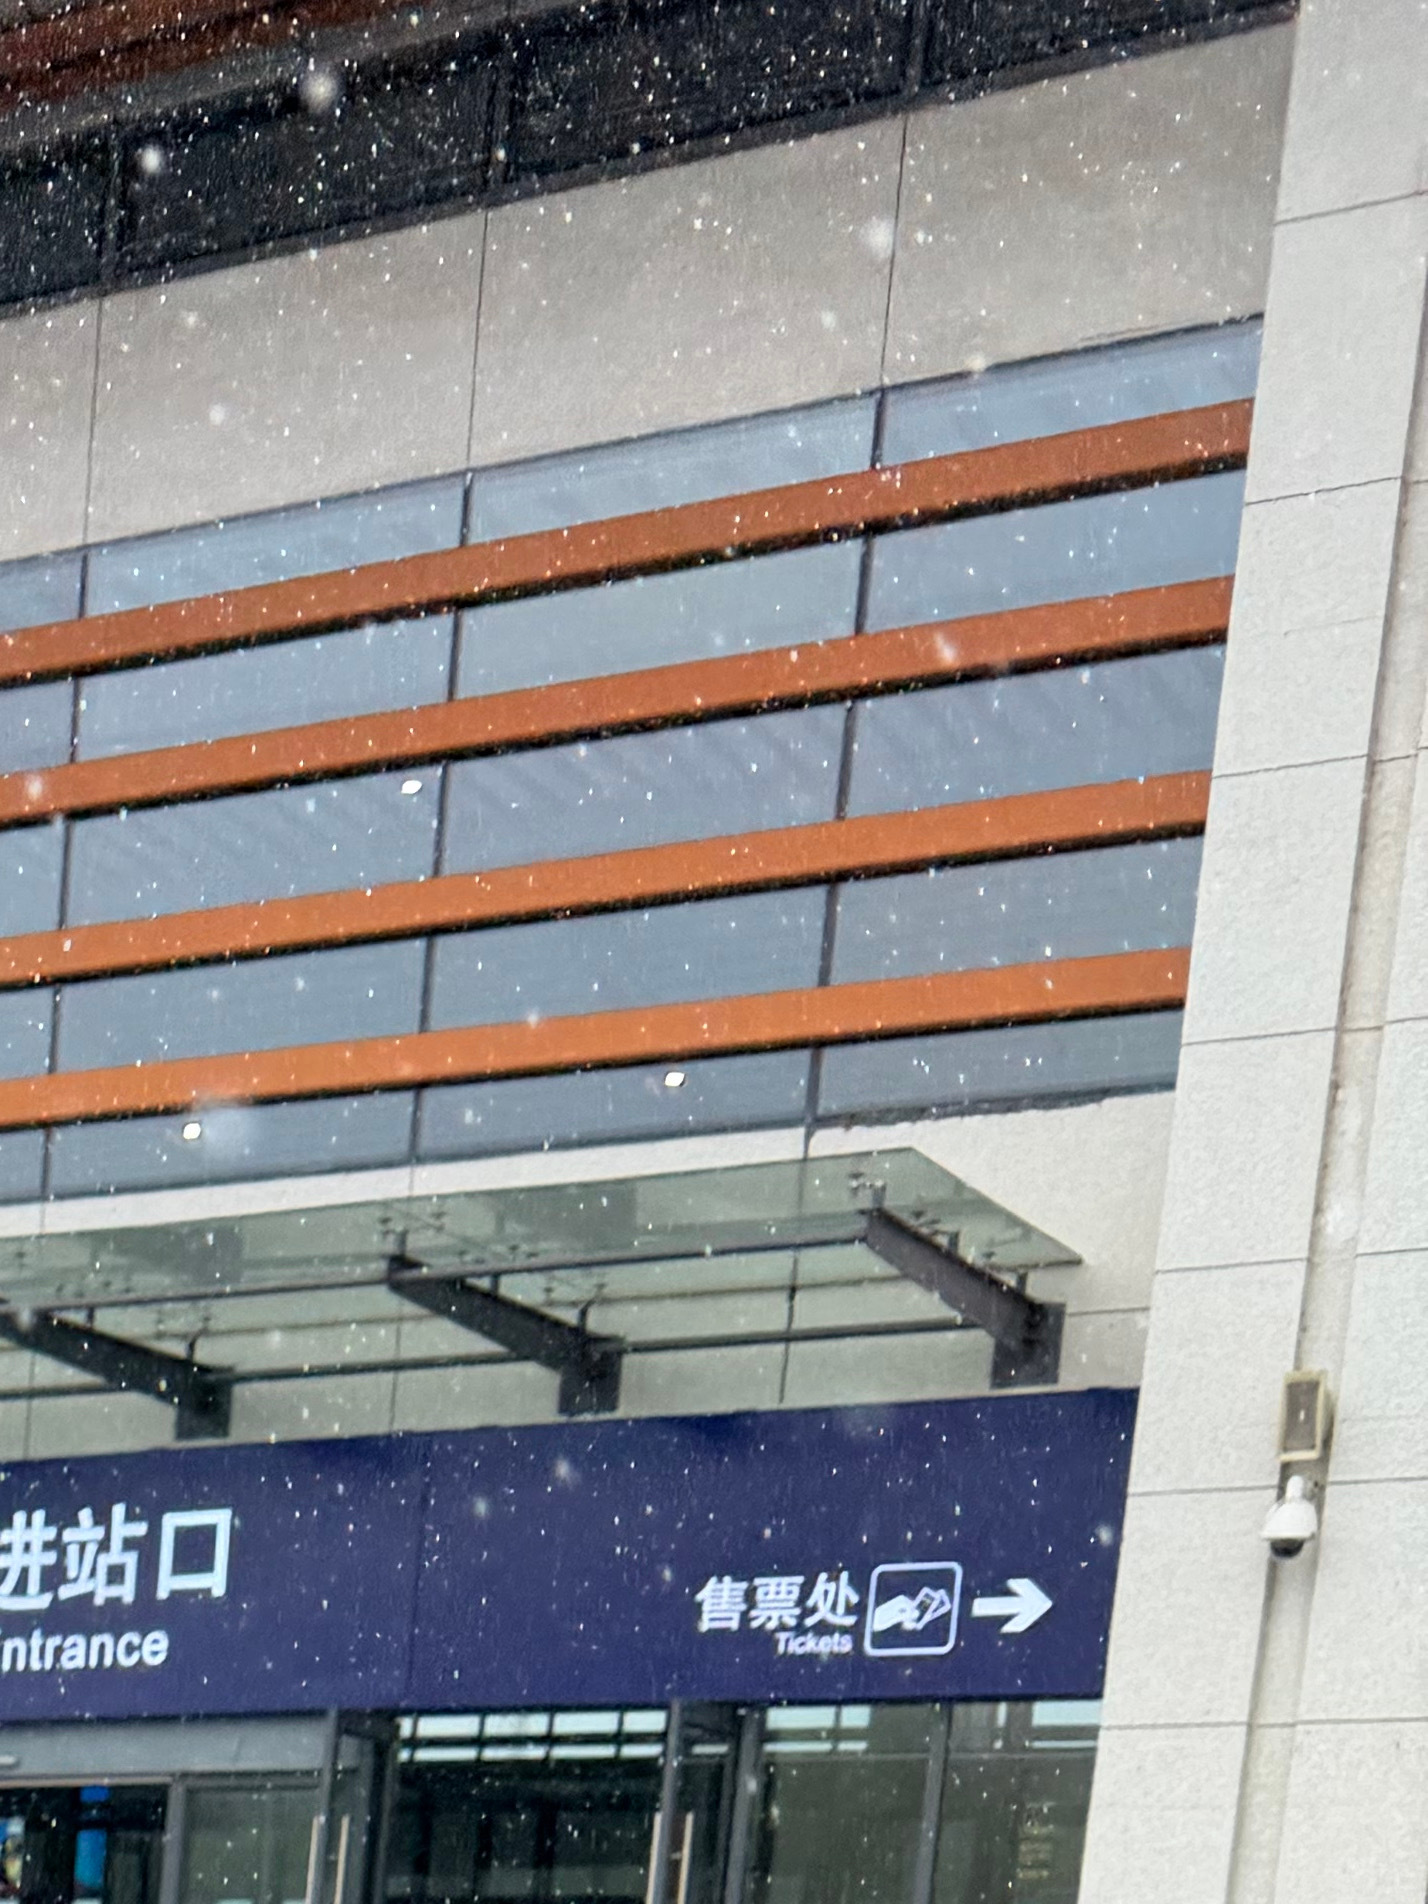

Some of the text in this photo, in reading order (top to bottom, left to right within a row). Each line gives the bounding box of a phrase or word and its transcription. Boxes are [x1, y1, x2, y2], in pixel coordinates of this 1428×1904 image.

[695, 1571, 859, 1632] 售票处
[775, 1631, 853, 1656] Tickets
